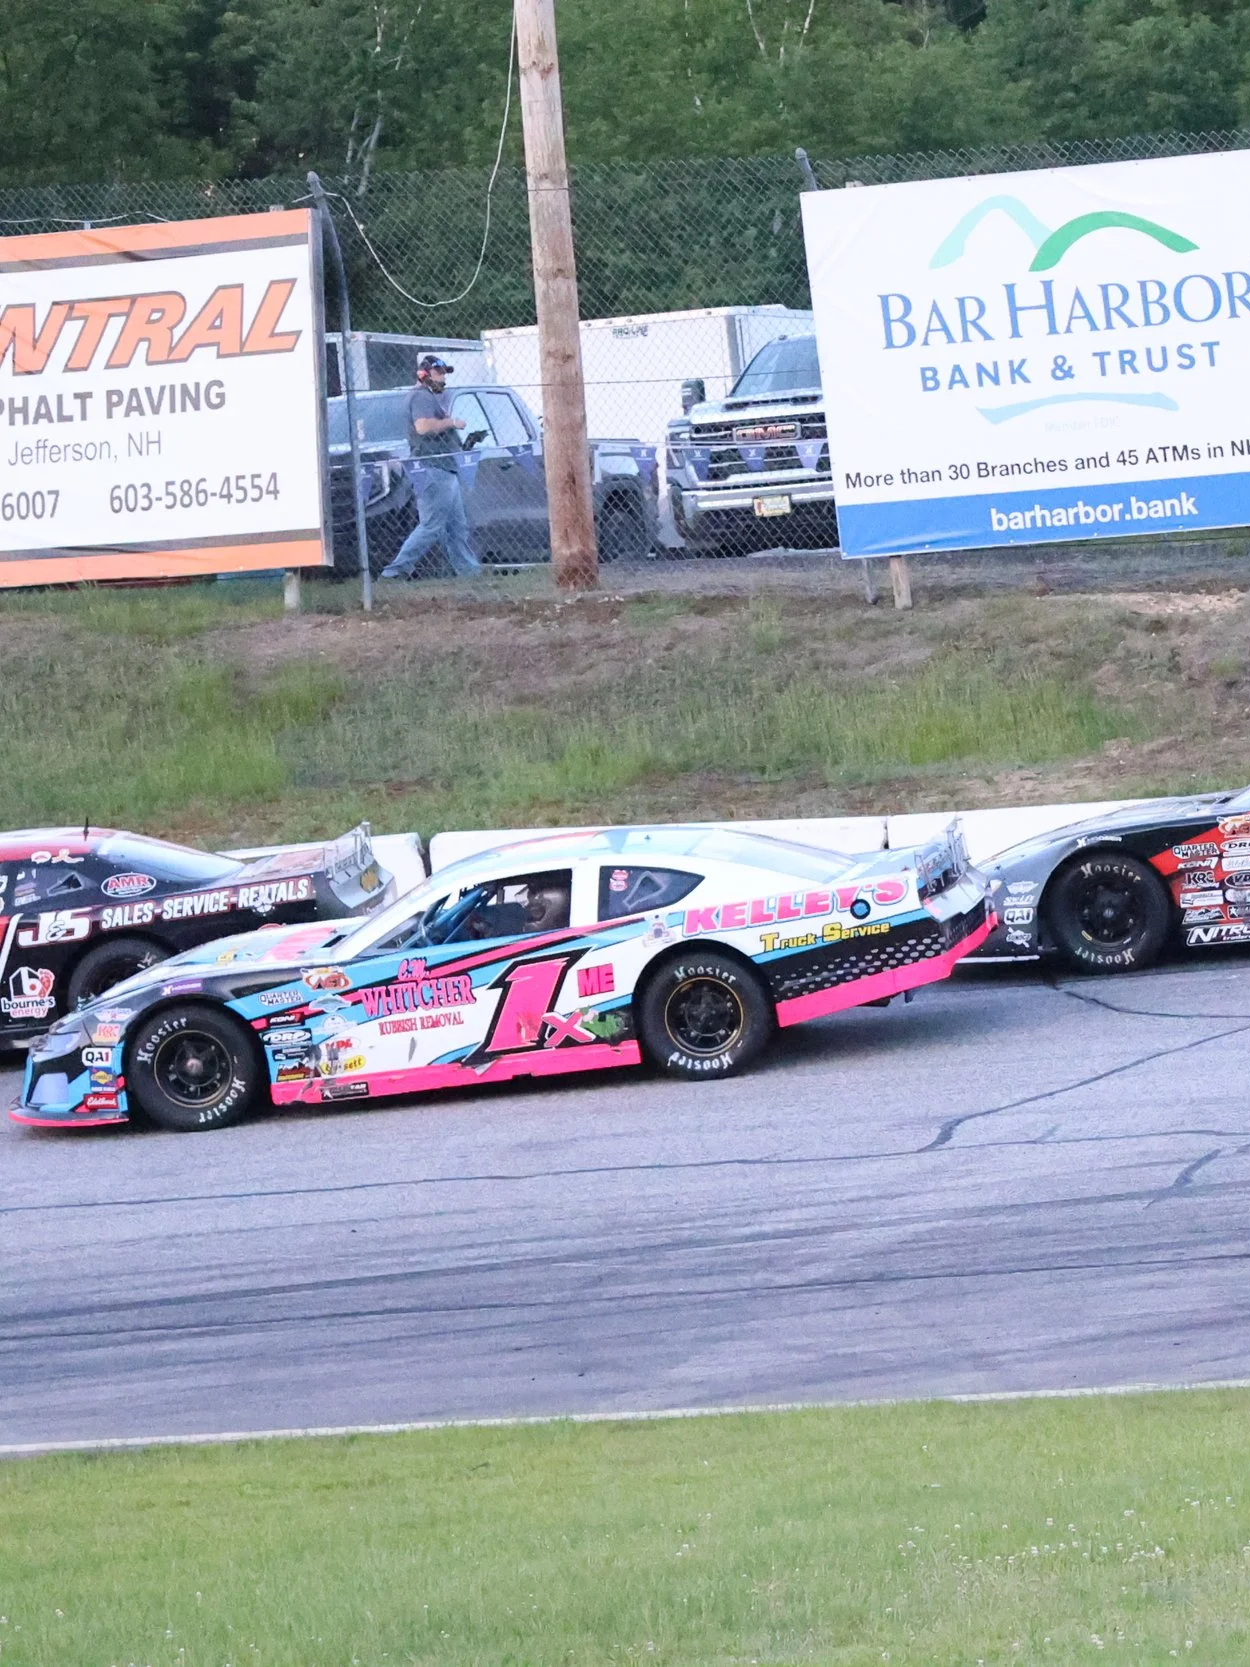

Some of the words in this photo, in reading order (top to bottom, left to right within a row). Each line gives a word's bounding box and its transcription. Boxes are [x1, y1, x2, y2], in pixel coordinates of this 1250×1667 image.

[920, 358, 1031, 392] BANK
[1051, 355, 1075, 380] &
[1092, 341, 1220, 377] TRUST
[0, 391, 93, 426] HALT
[106, 379, 226, 419] PAVING
[8, 437, 118, 466] Jefferson,
[128, 430, 162, 457] NH
[845, 471, 894, 490] More
[900, 468, 942, 485] than
[948, 463, 970, 481] 30
[976, 457, 1069, 479] Branches
[1074, 451, 1110, 470] and
[1116, 449, 1139, 466] 45
[1145, 444, 1201, 464] ATMs
[1207, 442, 1225, 458] in
[110, 472, 280, 514] 603-586-4554
[991, 491, 1199, 532] barharbor.bank
[1174, 843, 1215, 854] QUARTER
[106, 875, 149, 888] AMR
[1080, 862, 1141, 883] Hoosier
[1187, 872, 1215, 885] KRC
[684, 879, 908, 936] KELLEY'S
[1006, 909, 1031, 923] QA1
[1075, 947, 1135, 965] Hoosier
[577, 963, 615, 998] ME
[674, 965, 737, 984] Hoosier
[359, 973, 477, 1017] WHITCHER
[12, 1005, 48, 1018] energy
[379, 1017, 418, 1036] RUBBISH
[420, 1012, 465, 1031] REMOVAL
[137, 1017, 188, 1065] Hoosier
[85, 1051, 110, 1063] QA1
[667, 1052, 733, 1070] Hoosier
[199, 1075, 246, 1123] Hoosier
